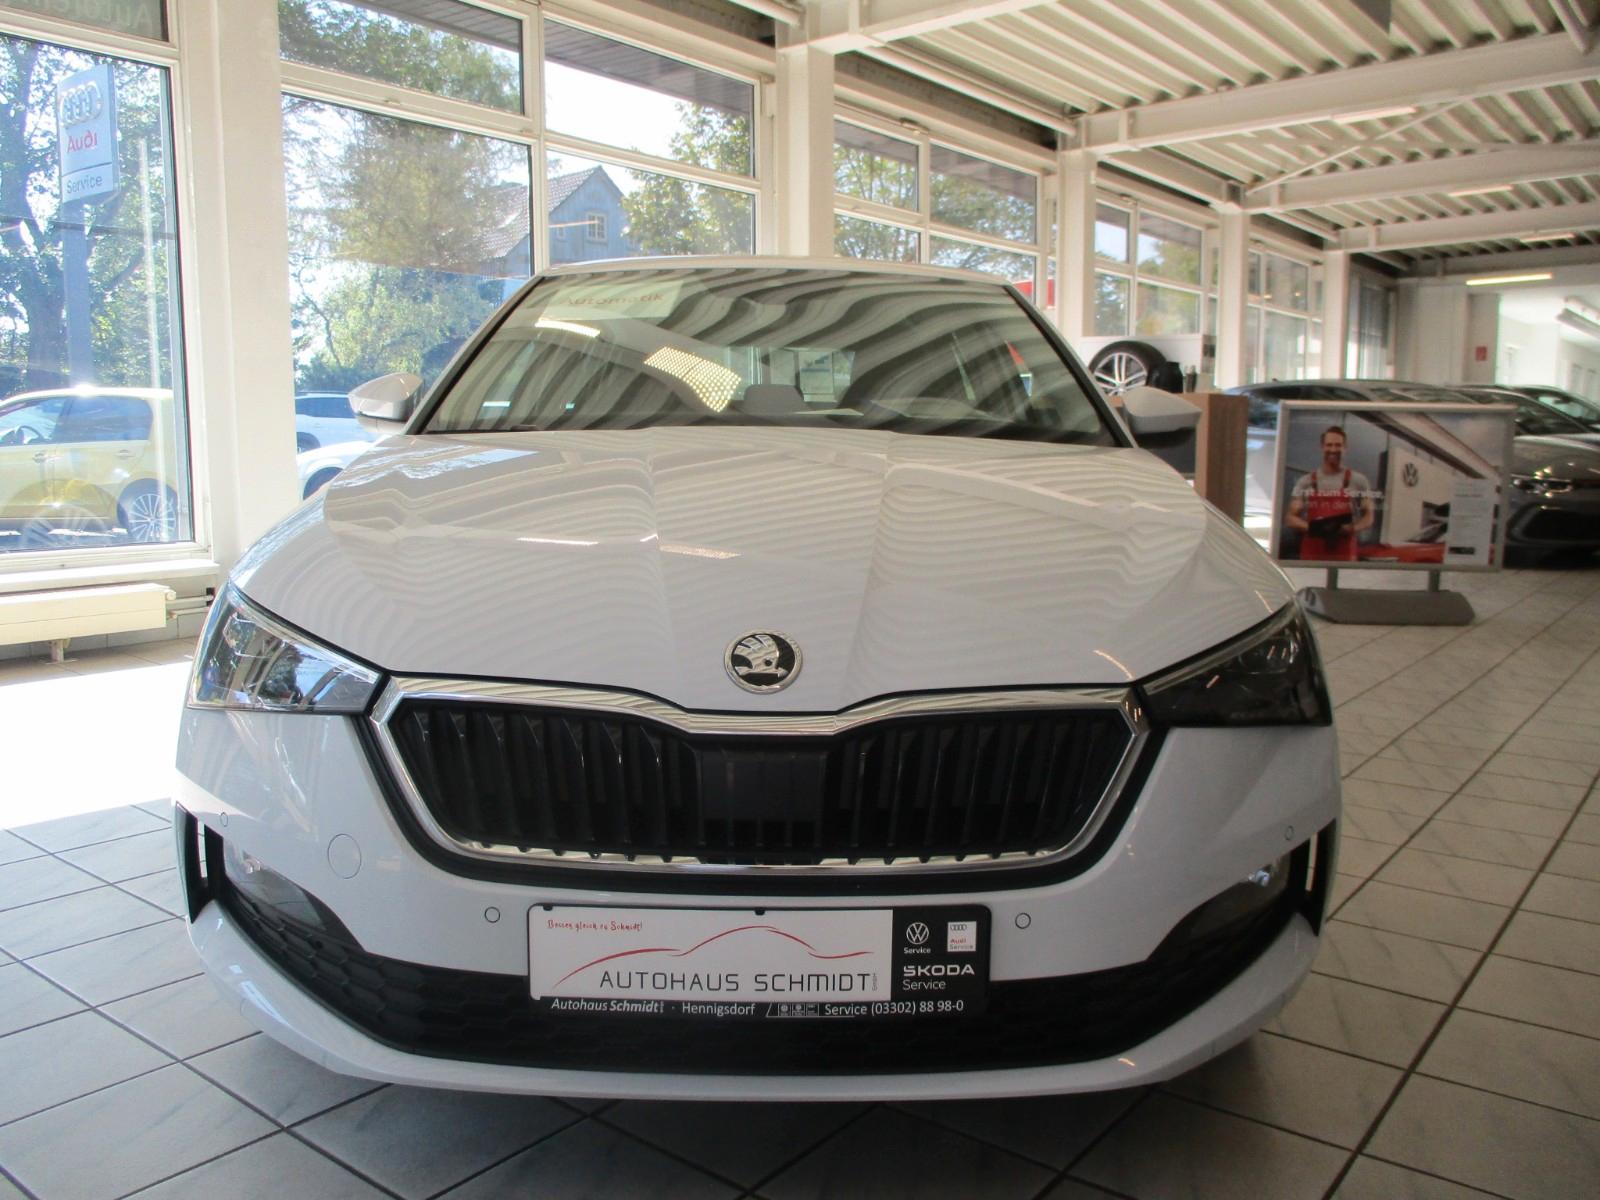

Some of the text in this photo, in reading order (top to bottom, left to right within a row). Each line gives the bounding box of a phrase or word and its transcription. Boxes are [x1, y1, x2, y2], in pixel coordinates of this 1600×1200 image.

[67, 130, 98, 153] Audi
[66, 174, 103, 194] Service
[600, 970, 739, 992] AUTOHAUS
[754, 973, 870, 992] SCHMIDT
[902, 979, 946, 991] Service
[551, 998, 608, 1012] Autohaus
[609, 1000, 659, 1013] Schmidt
[682, 1002, 757, 1017] Hennigsdorf
[824, 1003, 868, 1016] Service
[871, 1001, 917, 1017] (03302)
[919, 1001, 934, 1013] 88
[937, 999, 964, 1012] 98-0
